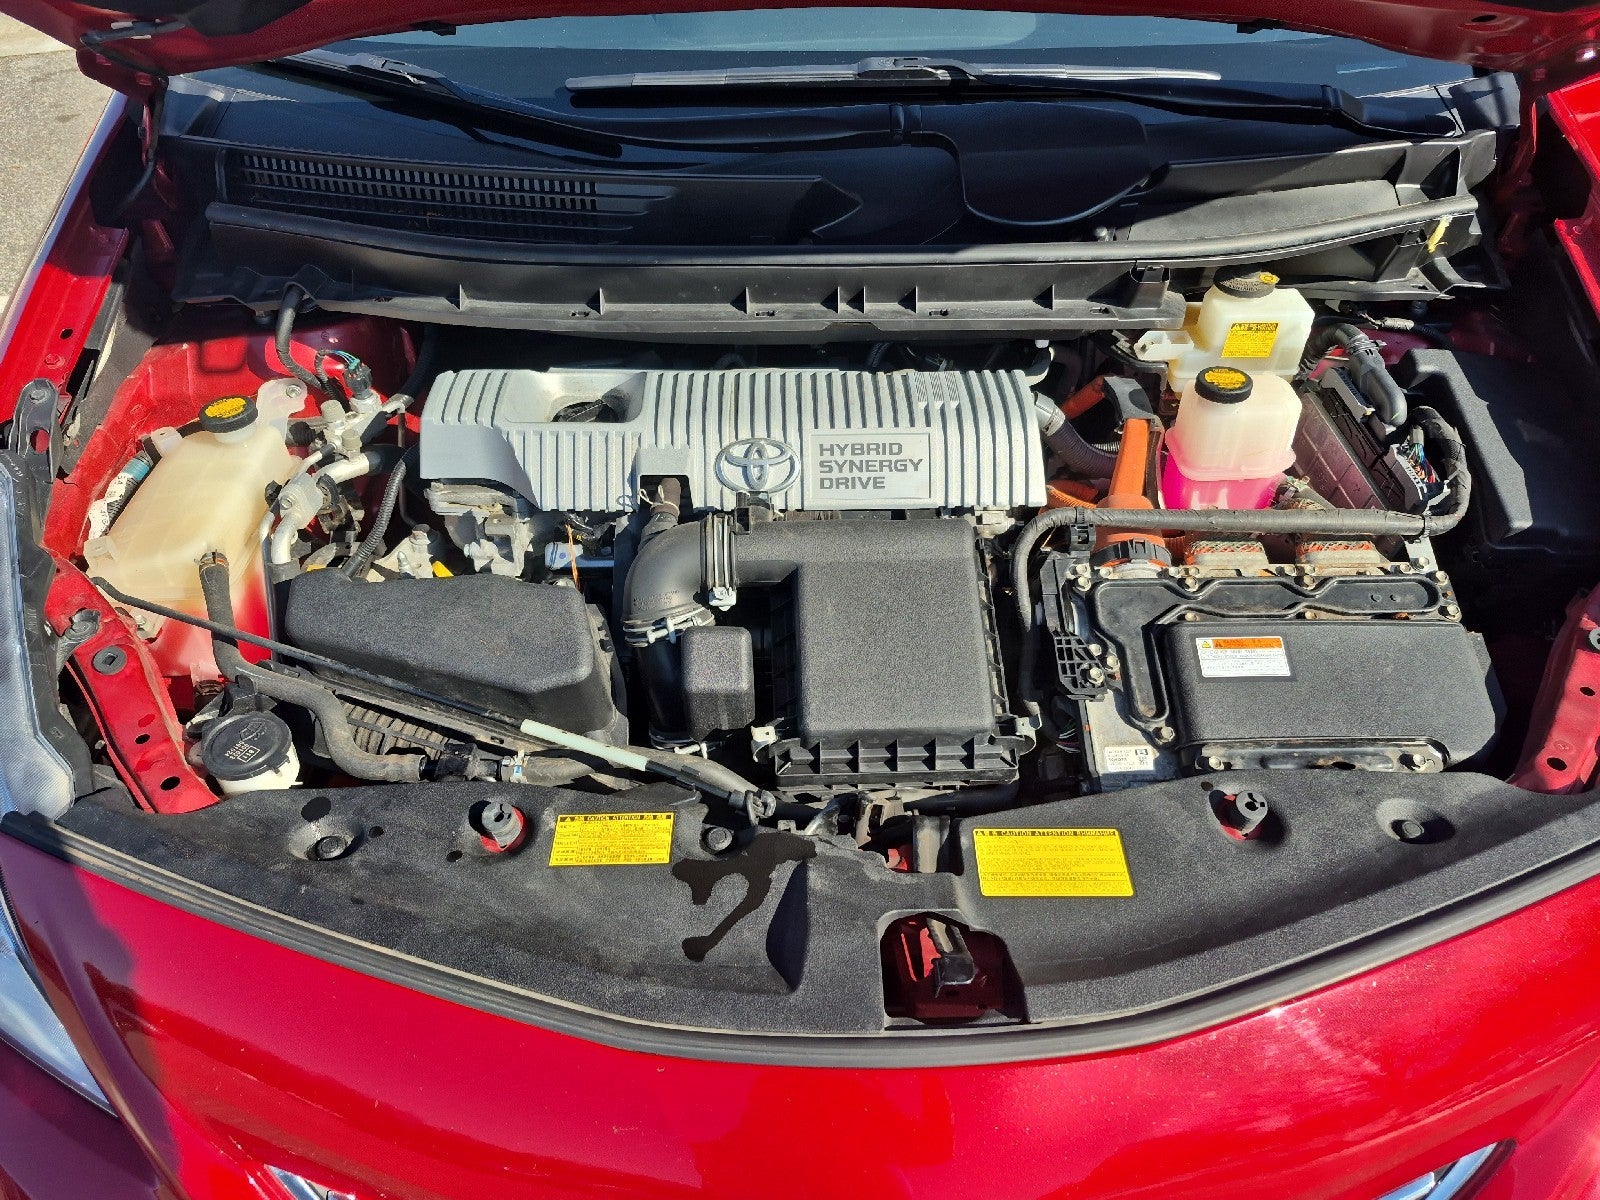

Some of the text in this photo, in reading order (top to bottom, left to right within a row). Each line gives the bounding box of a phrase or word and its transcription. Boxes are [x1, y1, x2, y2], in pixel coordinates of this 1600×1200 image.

[819, 443, 902, 456] HYBRID
[819, 459, 923, 473] SYNERGY
[820, 477, 885, 489] DRIVE
